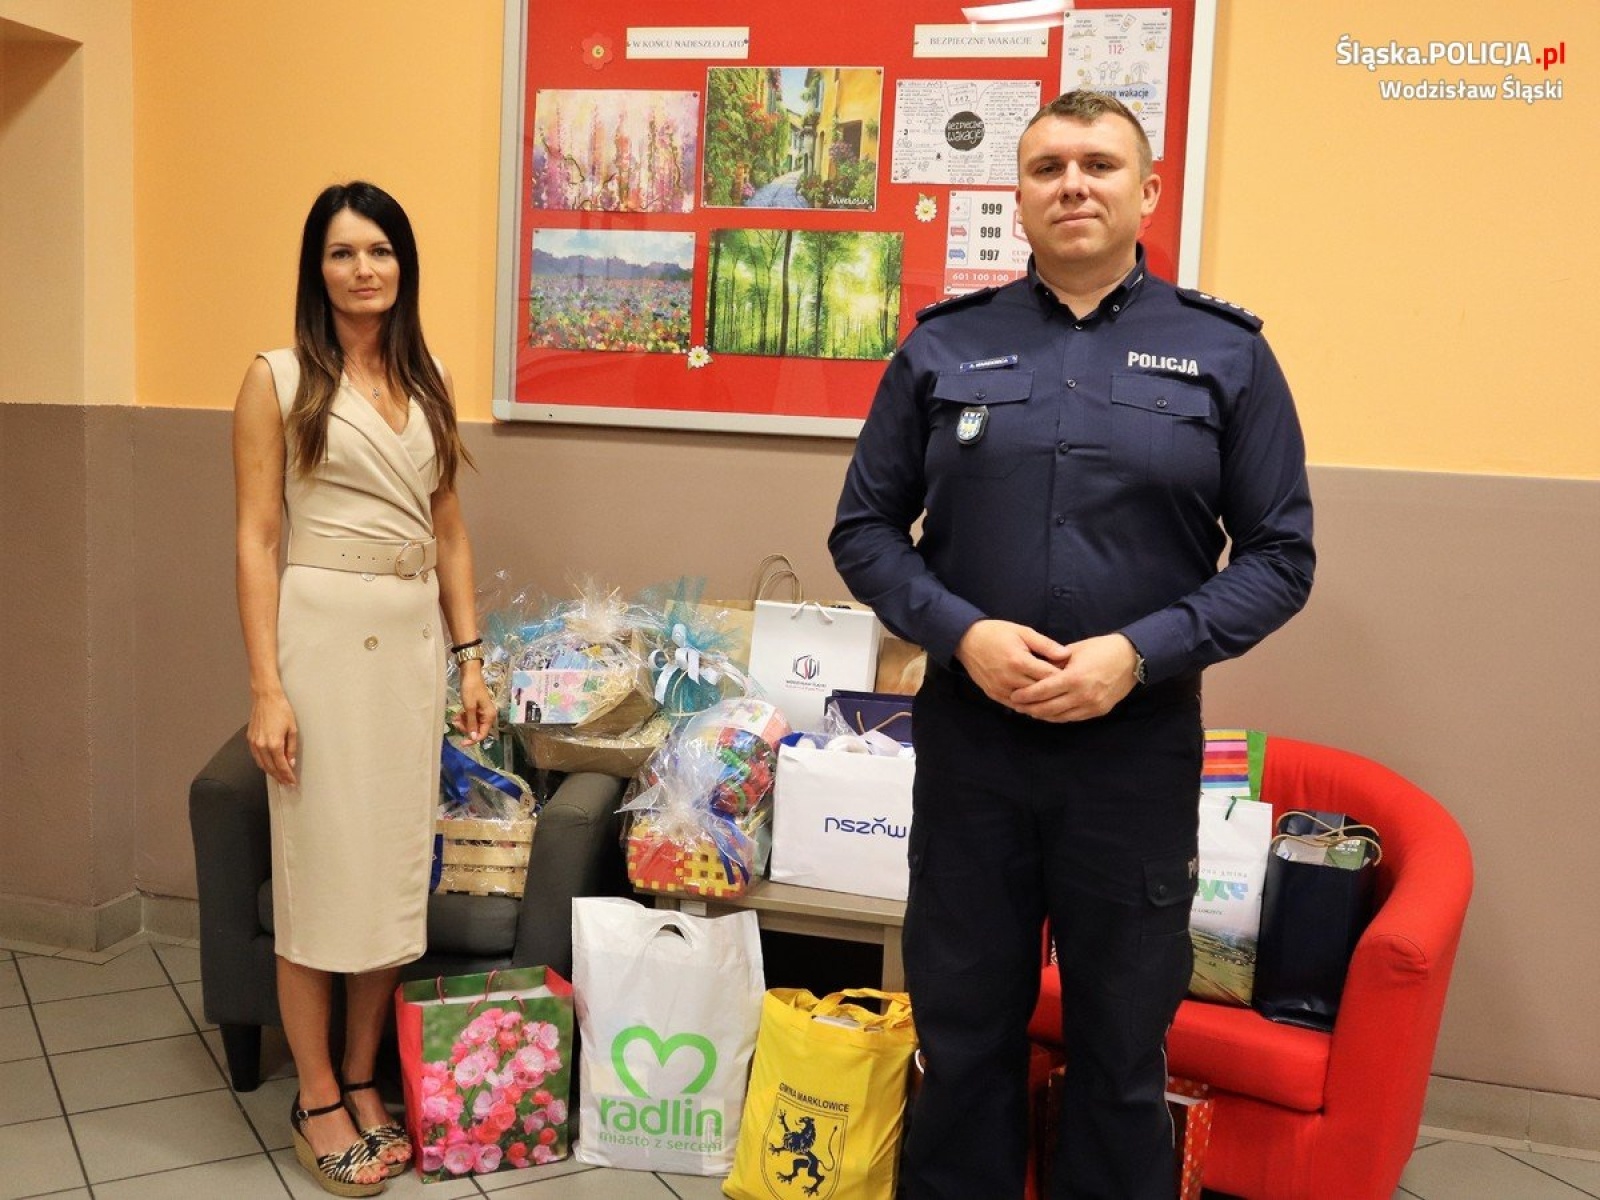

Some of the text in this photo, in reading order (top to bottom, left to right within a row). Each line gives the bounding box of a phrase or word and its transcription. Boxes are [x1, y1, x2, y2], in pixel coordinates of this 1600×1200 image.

[632, 40, 640, 48] W
[981, 203, 1003, 215] 999
[980, 226, 1001, 238] 998
[979, 249, 1000, 261] 997
[952, 272, 1009, 281] 601 100 100
[1127, 351, 1199, 377] POLICJA
[796, 1090, 850, 1113] MARKLOWICE
[600, 1097, 723, 1137] radlin
[599, 1131, 723, 1153] miasto z sercem
